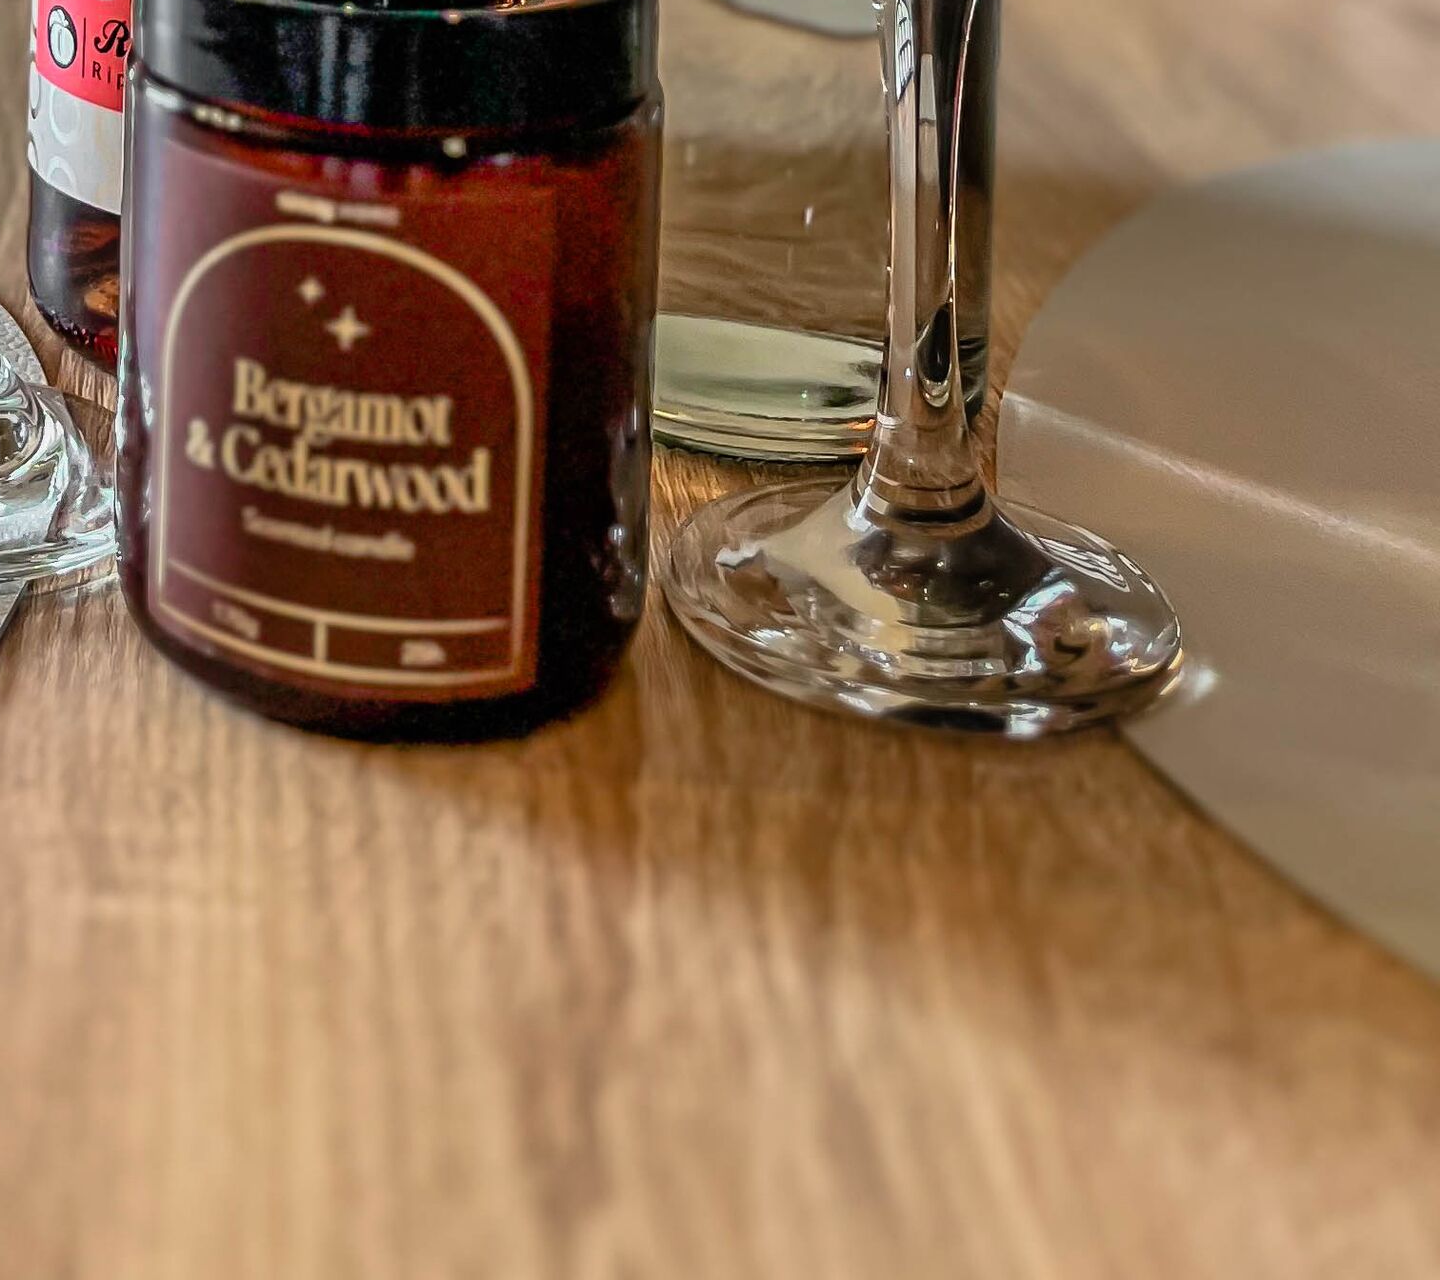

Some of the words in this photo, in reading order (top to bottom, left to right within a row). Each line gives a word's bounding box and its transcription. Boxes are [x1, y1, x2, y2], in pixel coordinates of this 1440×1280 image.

[232, 356, 453, 447] Bergamot
[184, 416, 215, 471] &
[220, 424, 491, 514] Cedarwood
